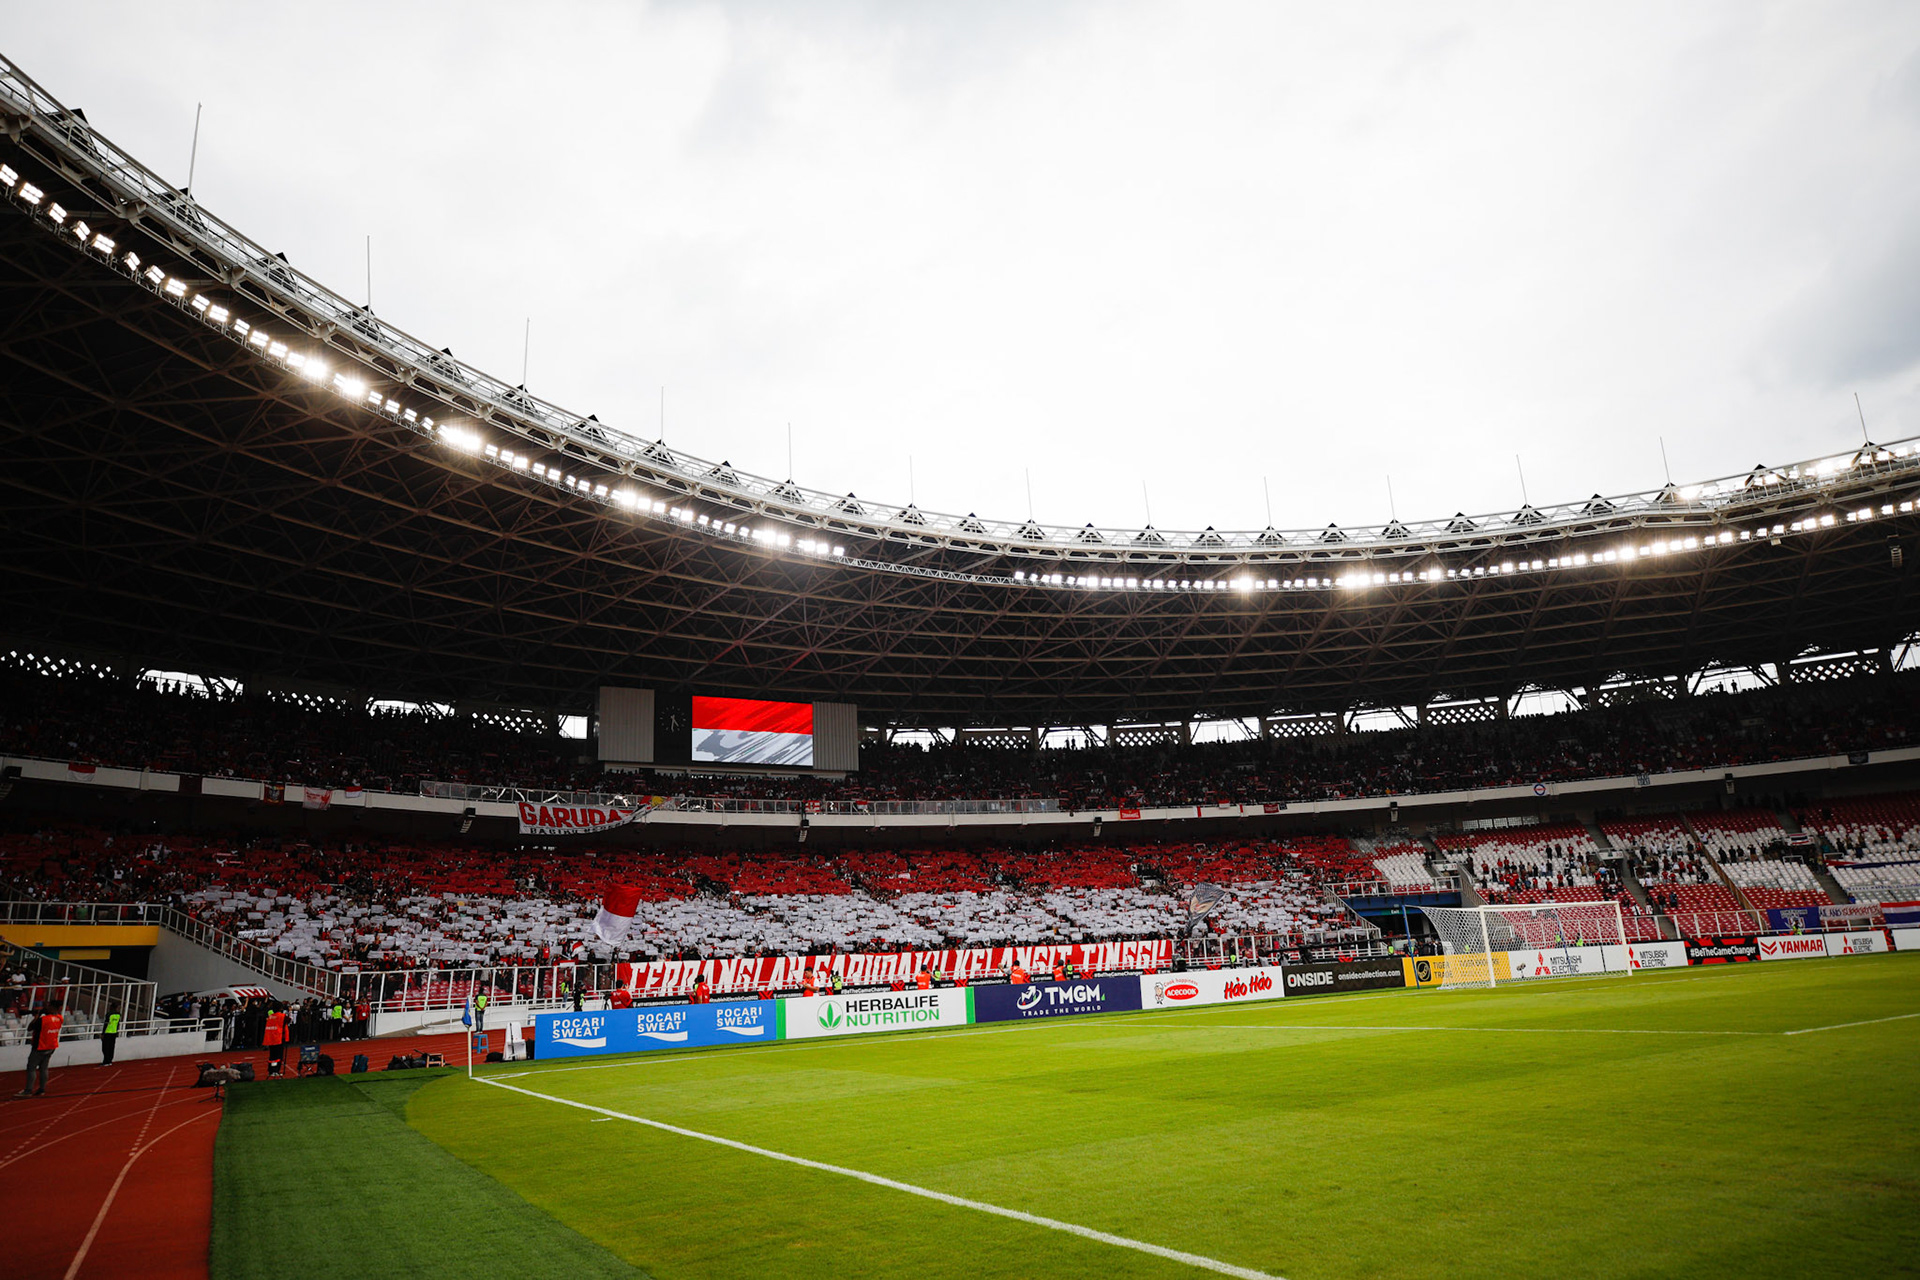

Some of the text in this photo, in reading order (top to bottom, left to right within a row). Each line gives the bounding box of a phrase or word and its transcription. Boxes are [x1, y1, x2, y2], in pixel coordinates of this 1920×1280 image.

[518, 801, 622, 828] GARUDA
[1690, 945, 1756, 957] #BeTheGameChanger
[1779, 938, 1824, 954] YANMAR
[24, 951, 40, 959] Exi
[1639, 949, 1669, 959] MITSUBISHI
[1432, 961, 1450, 970] TIGER
[1641, 958, 1667, 968] ELECTRIC
[1287, 971, 1334, 988] ONSIDE
[1338, 969, 1401, 980] onsidecollection.com
[1044, 984, 1100, 1005] TMGM
[846, 995, 939, 1013] HERBALIFE
[637, 1011, 686, 1024] POCARI
[716, 1006, 763, 1018] POCARI
[846, 1008, 940, 1027] NUTRITION
[1022, 1008, 1049, 1016] TRADE
[552, 1016, 605, 1030] POCARI
[637, 1020, 682, 1033] SWEAT
[716, 1015, 759, 1027] SWEAT
[552, 1026, 600, 1039] SWEAT
